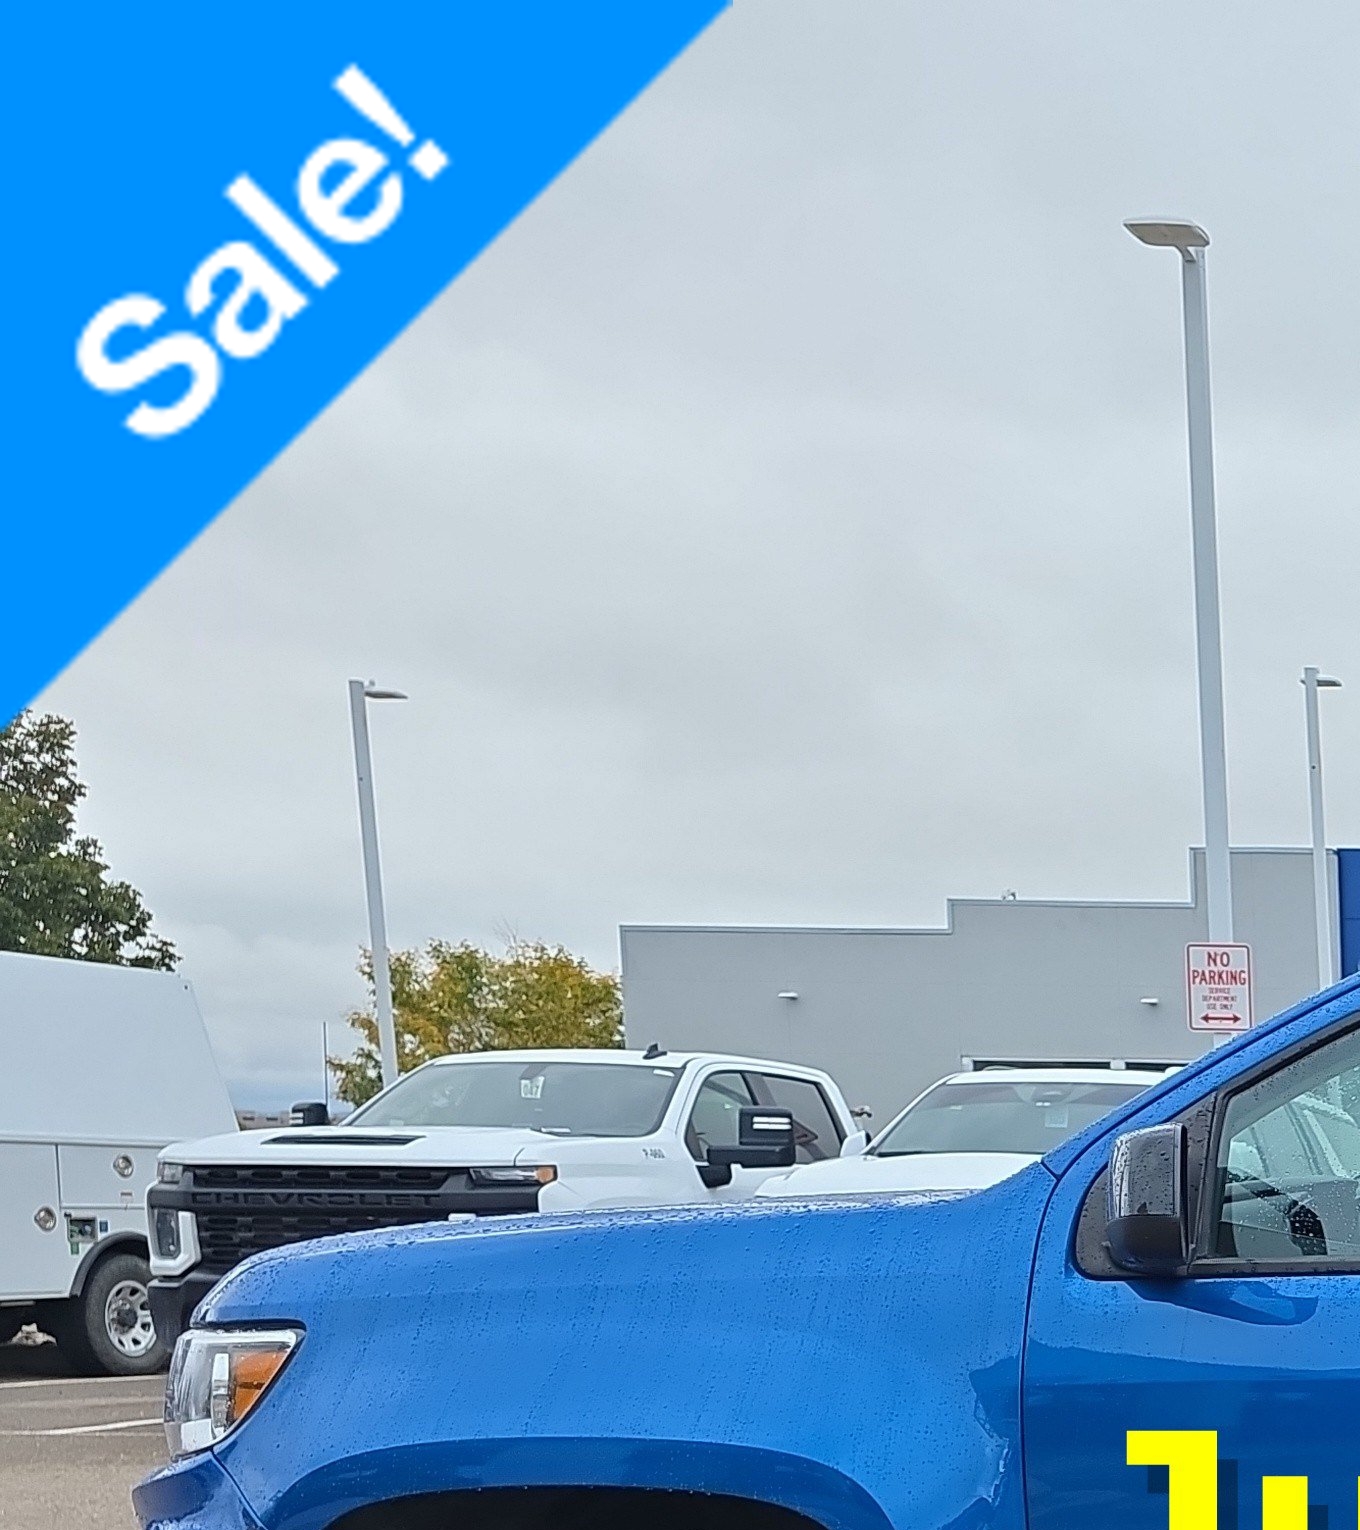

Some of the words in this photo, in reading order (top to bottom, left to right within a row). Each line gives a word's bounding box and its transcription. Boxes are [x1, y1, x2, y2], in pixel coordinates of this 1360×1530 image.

[1207, 951, 1230, 968] NO
[1191, 969, 1247, 986] PARKING
[191, 1191, 442, 1209] CHEVROLET
